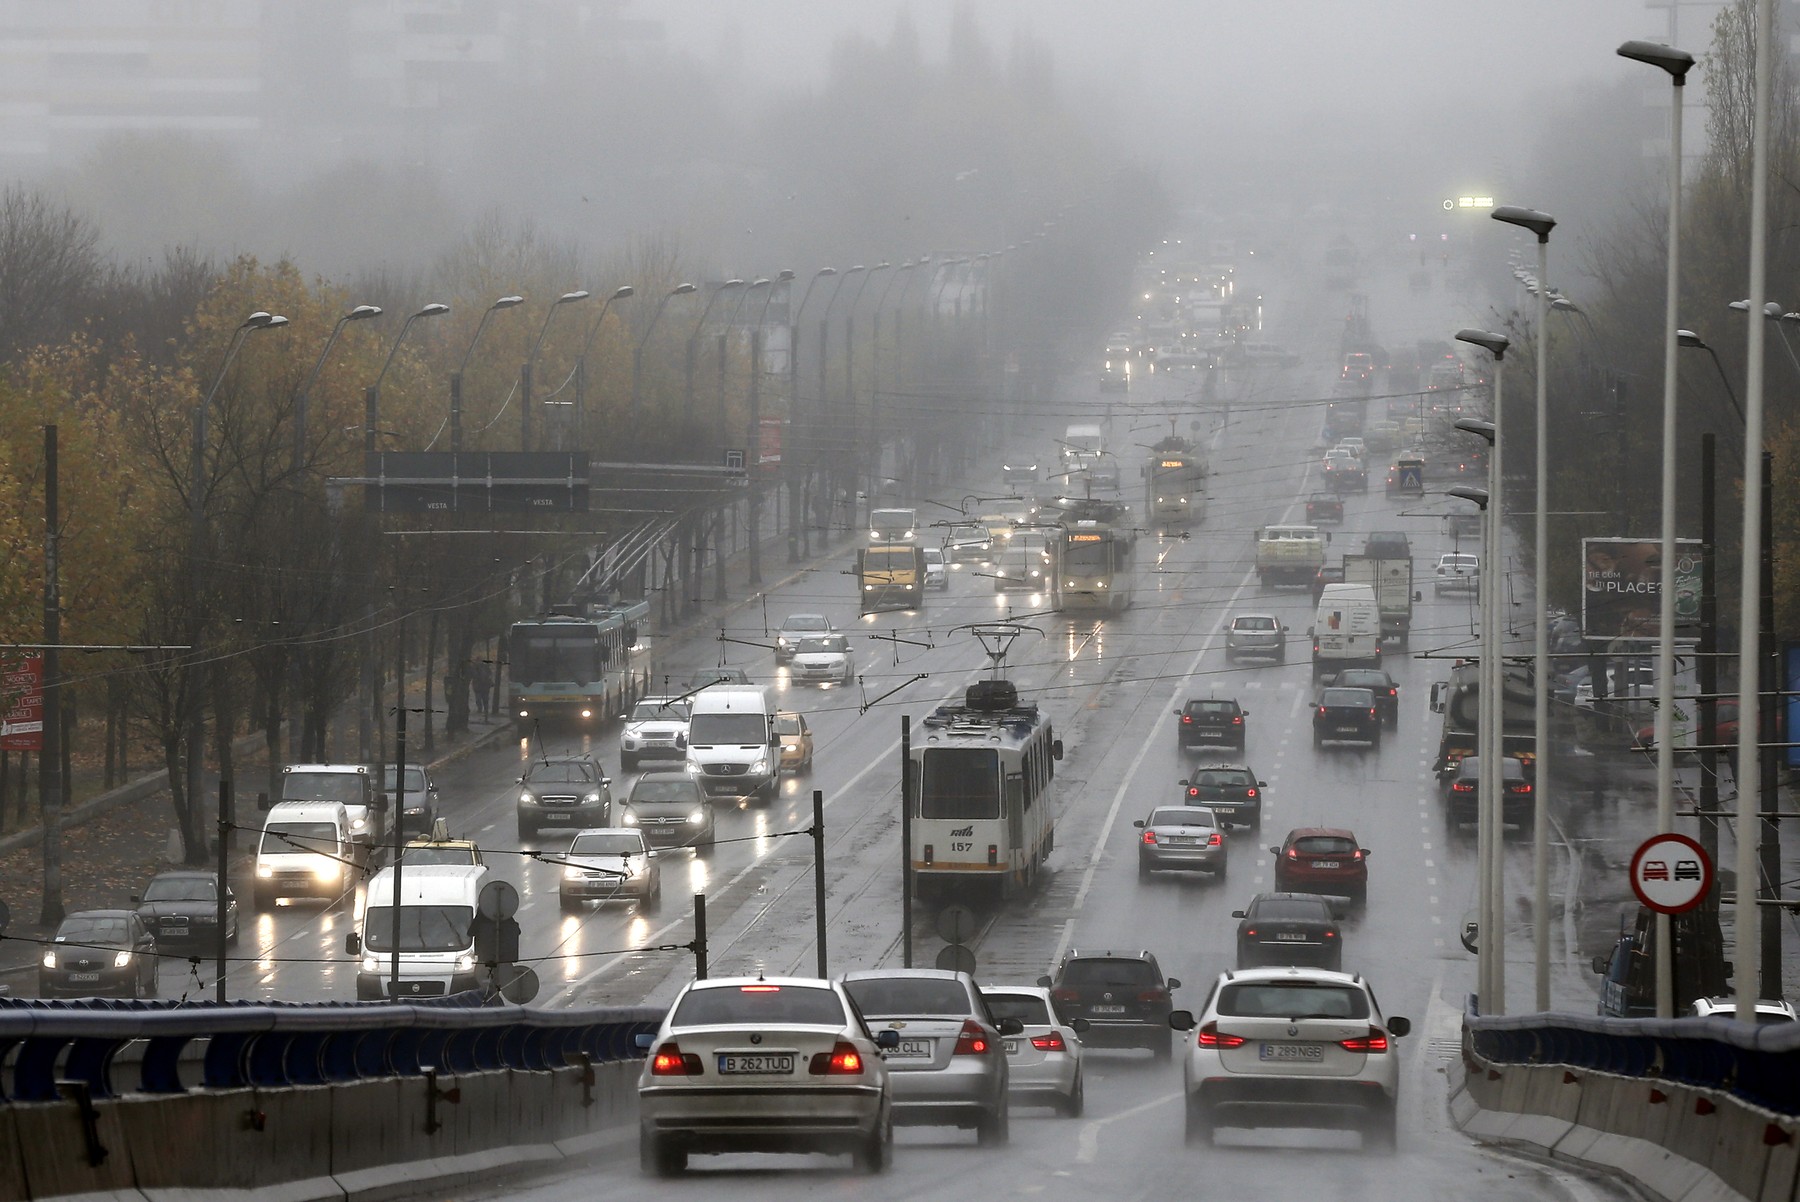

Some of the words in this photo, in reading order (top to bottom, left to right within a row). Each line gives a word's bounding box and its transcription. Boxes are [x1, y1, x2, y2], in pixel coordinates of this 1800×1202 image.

[427, 502, 448, 510] VESTA
[533, 499, 554, 507] VESTA
[951, 842, 973, 852] 157
[902, 1042, 923, 1053] CLL
[1266, 1046, 1274, 1057] B
[727, 1057, 736, 1070] B
[740, 1057, 762, 1070] 262
[765, 1057, 790, 1070] TUD
